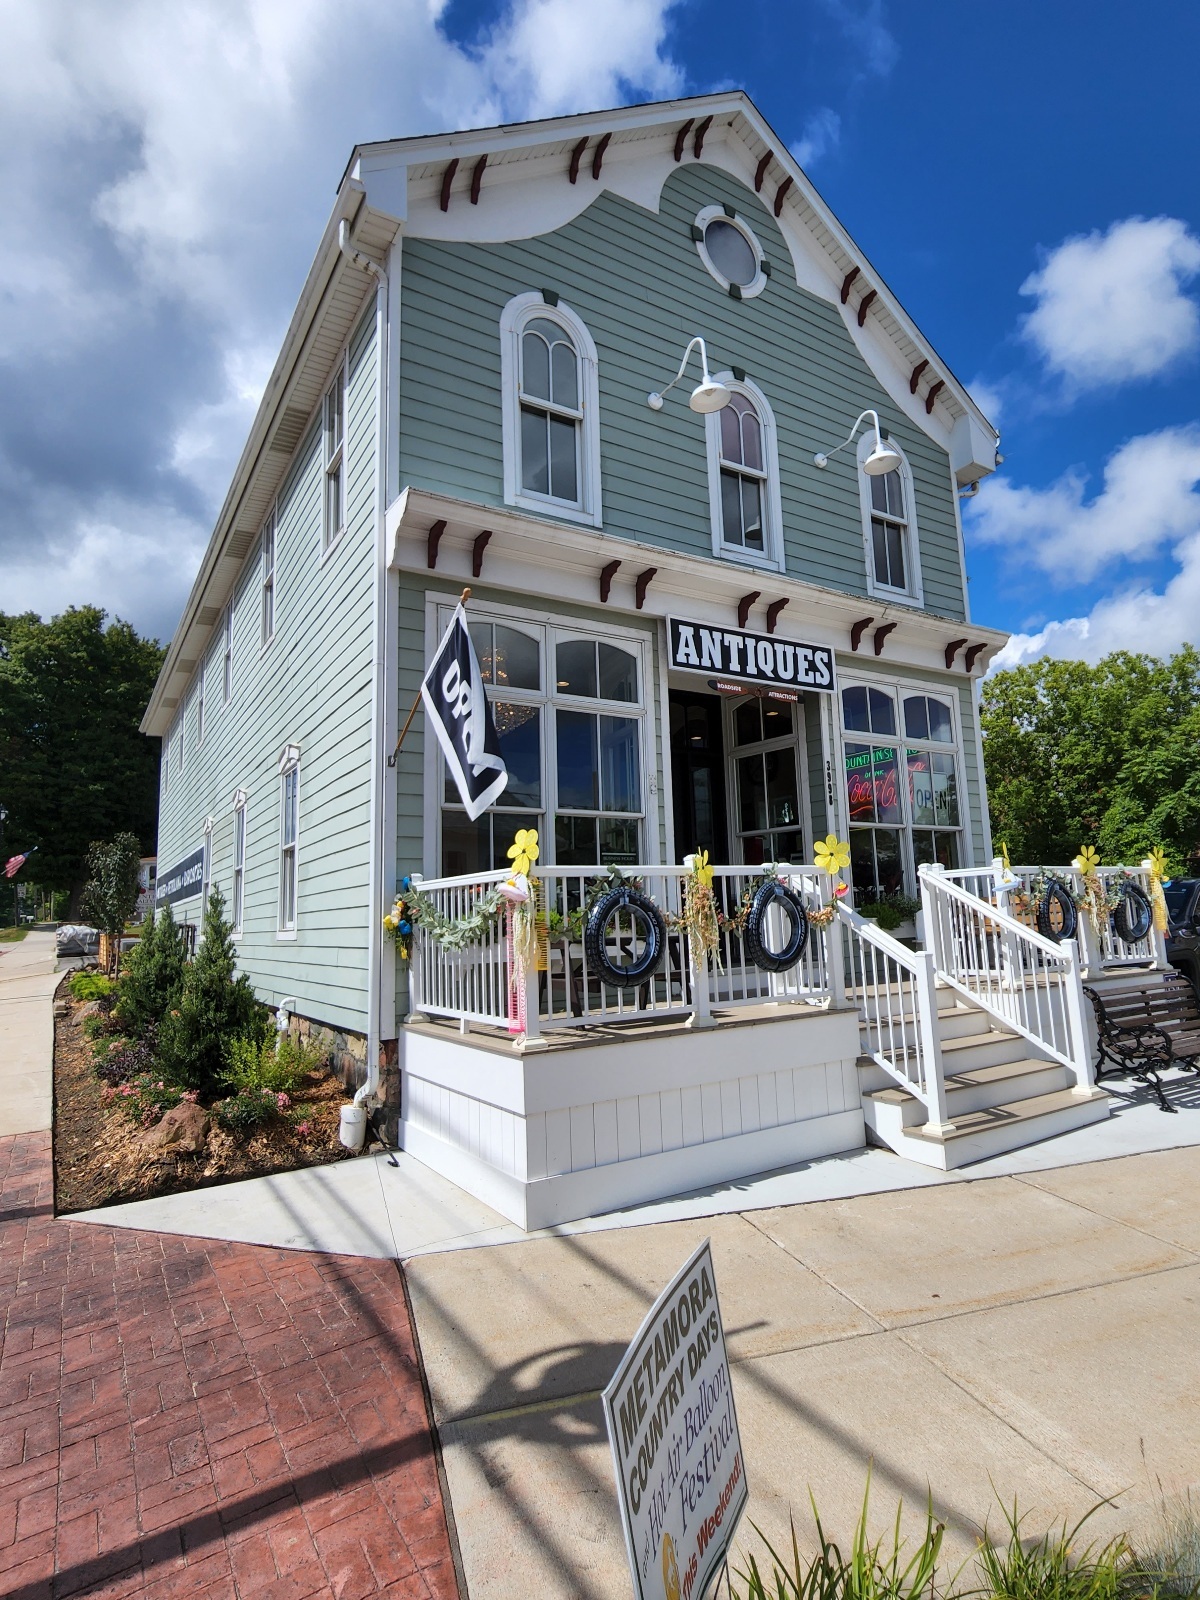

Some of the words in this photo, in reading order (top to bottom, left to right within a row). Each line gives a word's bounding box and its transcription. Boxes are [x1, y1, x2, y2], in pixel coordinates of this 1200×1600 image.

[675, 624, 831, 687] ANTIQUES
[717, 682, 742, 693] ROADSIDE
[768, 690, 799, 702] ATTRACTIONS
[619, 1266, 713, 1459] METAMORA
[630, 1356, 685, 1516] COUNTRY
[687, 1310, 719, 1381] DAYS
[648, 1472, 671, 1564] Hot
[667, 1433, 683, 1498] Air
[683, 1363, 726, 1457] Balloon
[679, 1390, 734, 1537] Festival
[683, 1552, 698, 1600] This
